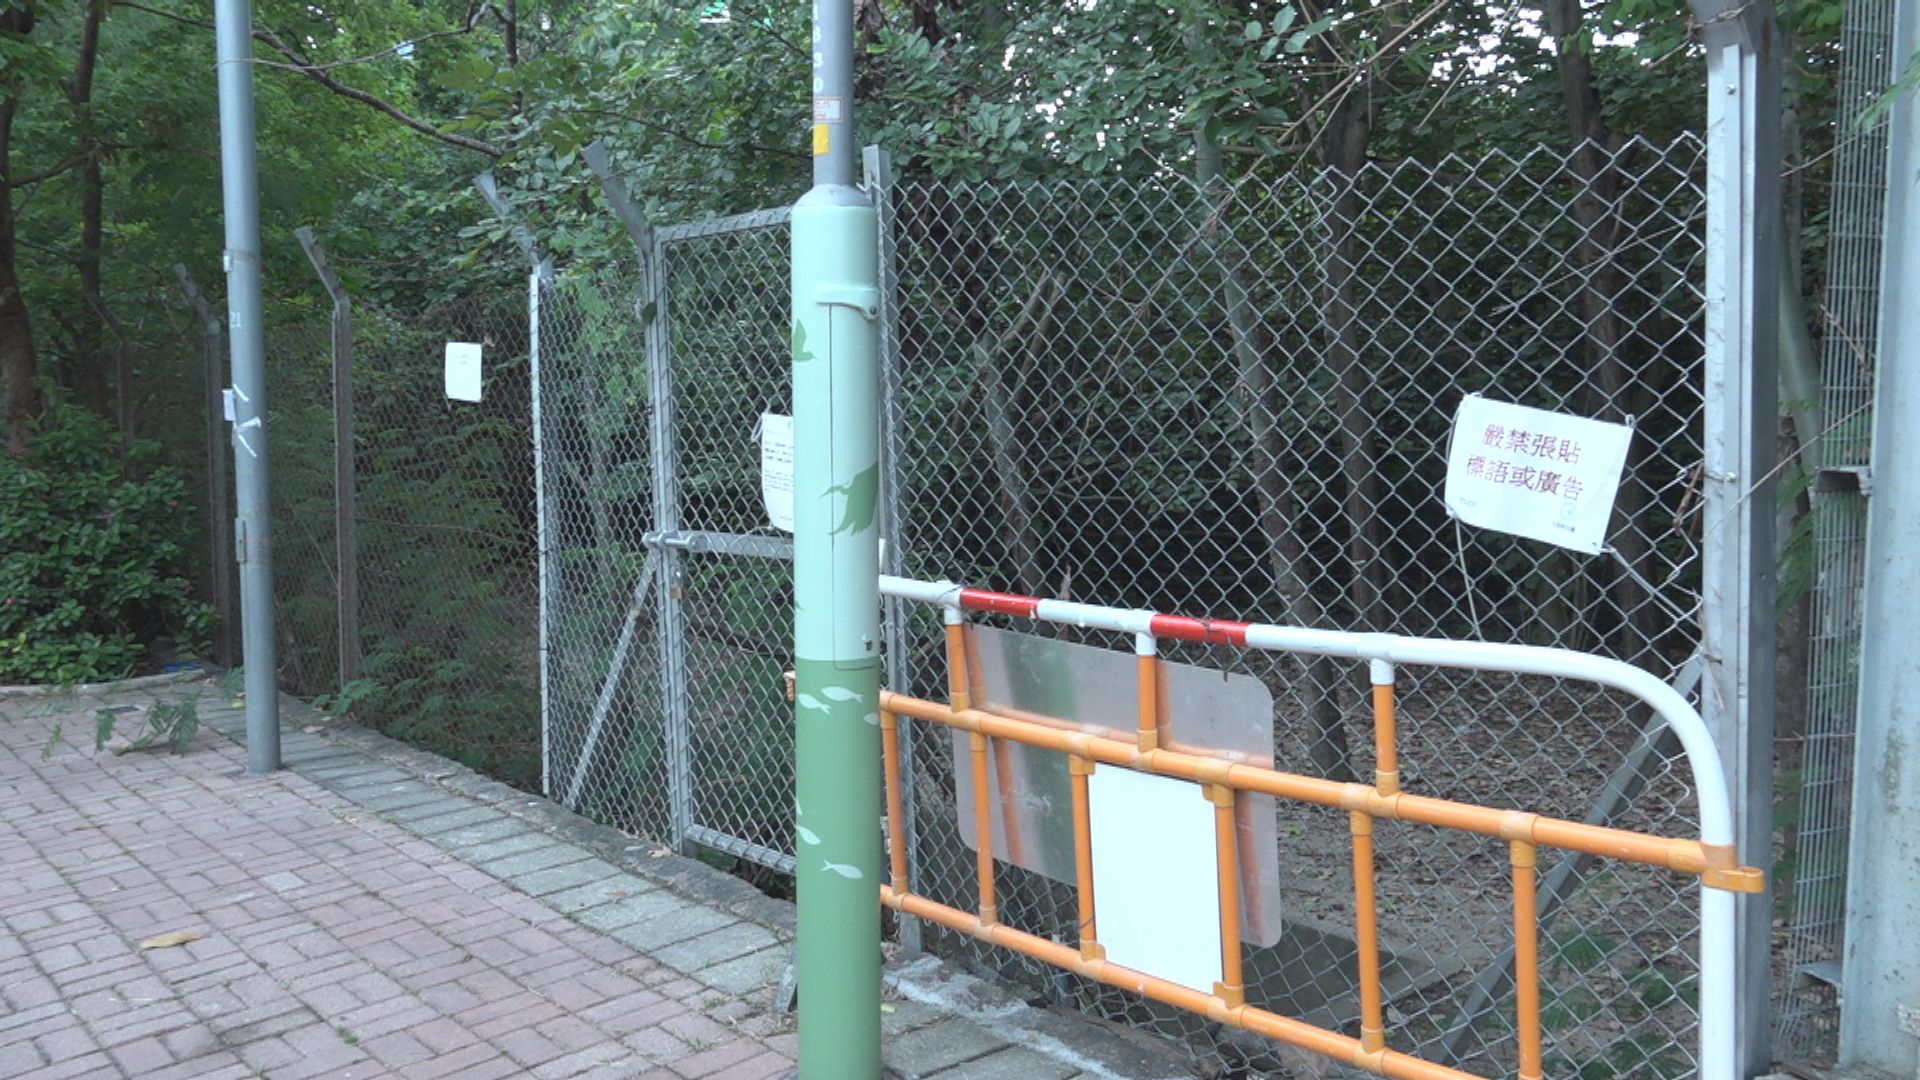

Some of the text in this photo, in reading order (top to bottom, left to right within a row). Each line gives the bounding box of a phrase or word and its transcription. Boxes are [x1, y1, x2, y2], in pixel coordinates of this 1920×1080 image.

[1482, 424, 1582, 465] 嚴禁張貼
[1466, 454, 1583, 501] 標語或廣告
